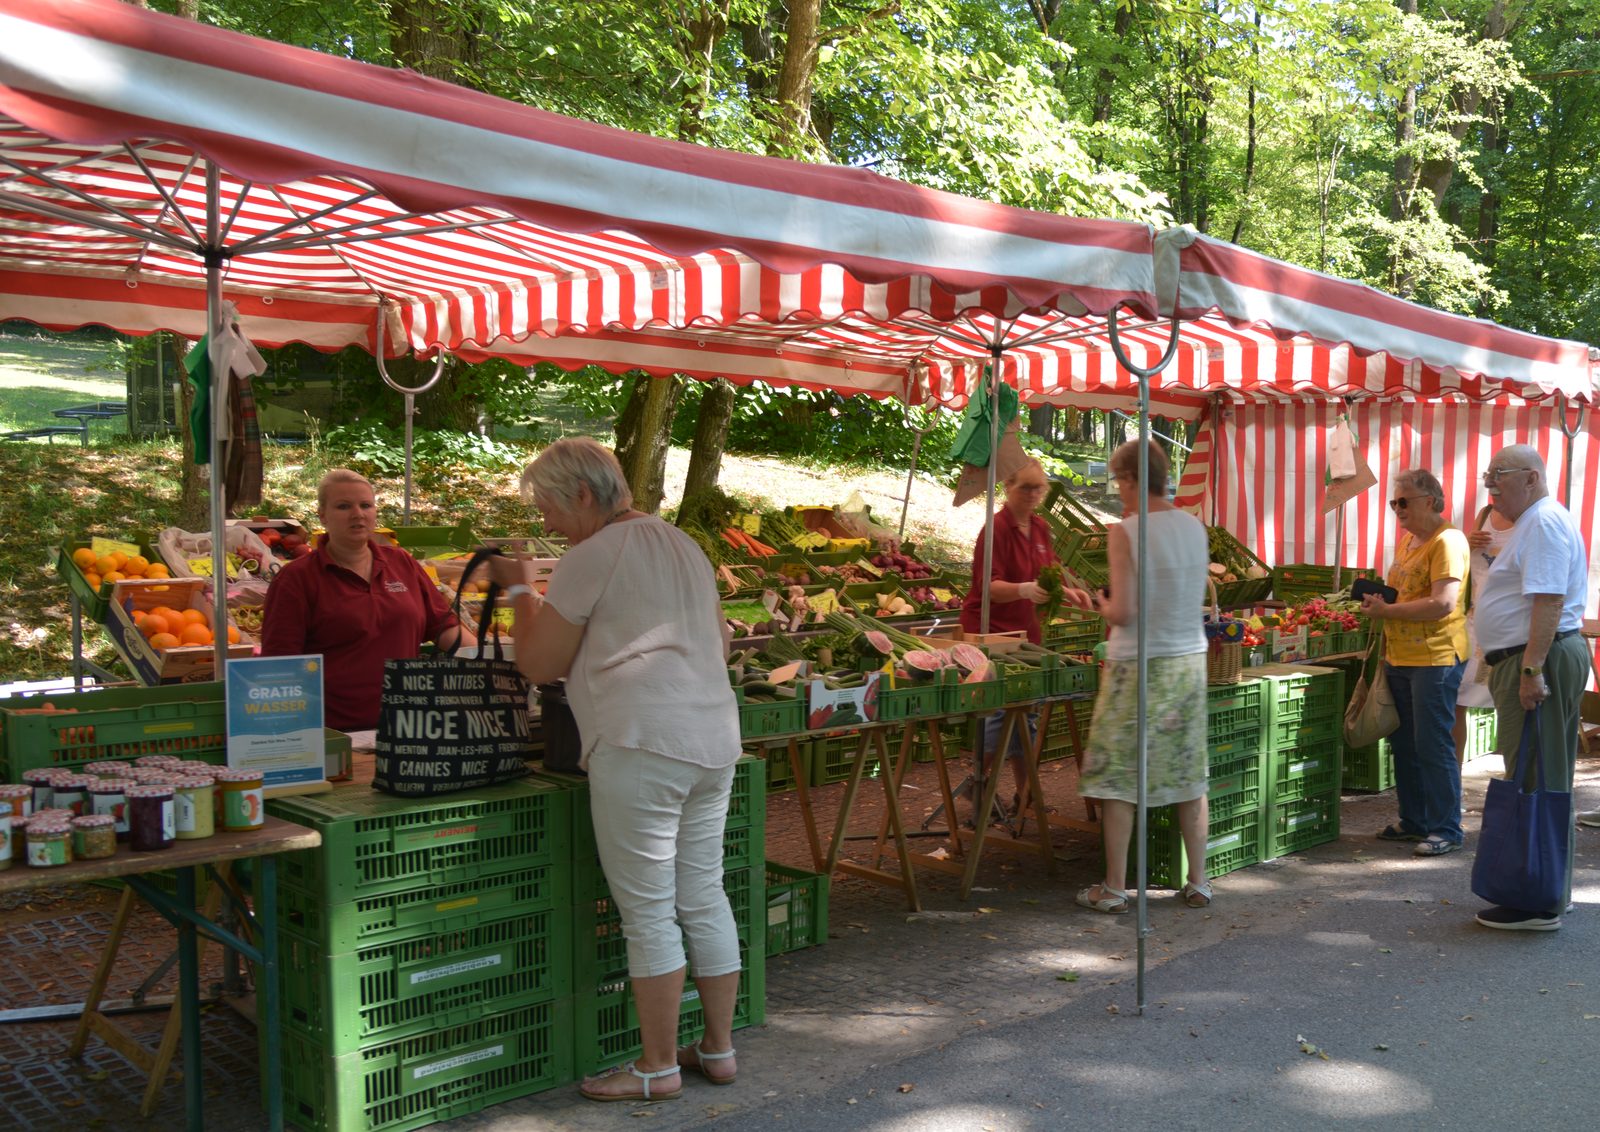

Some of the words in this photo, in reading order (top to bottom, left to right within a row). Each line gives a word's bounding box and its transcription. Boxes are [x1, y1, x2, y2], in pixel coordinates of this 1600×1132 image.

[403, 675, 435, 691] NICE
[443, 674, 485, 691] ANTIBES
[249, 686, 303, 699] GRATIS
[246, 701, 306, 714] WASSER
[396, 709, 459, 740] NICE
[465, 710, 511, 740] NICE
[394, 744, 428, 755] MENTON
[436, 743, 494, 756] JUAN-LES-PINS
[400, 760, 451, 777] CANNES
[461, 759, 489, 776] NICE
